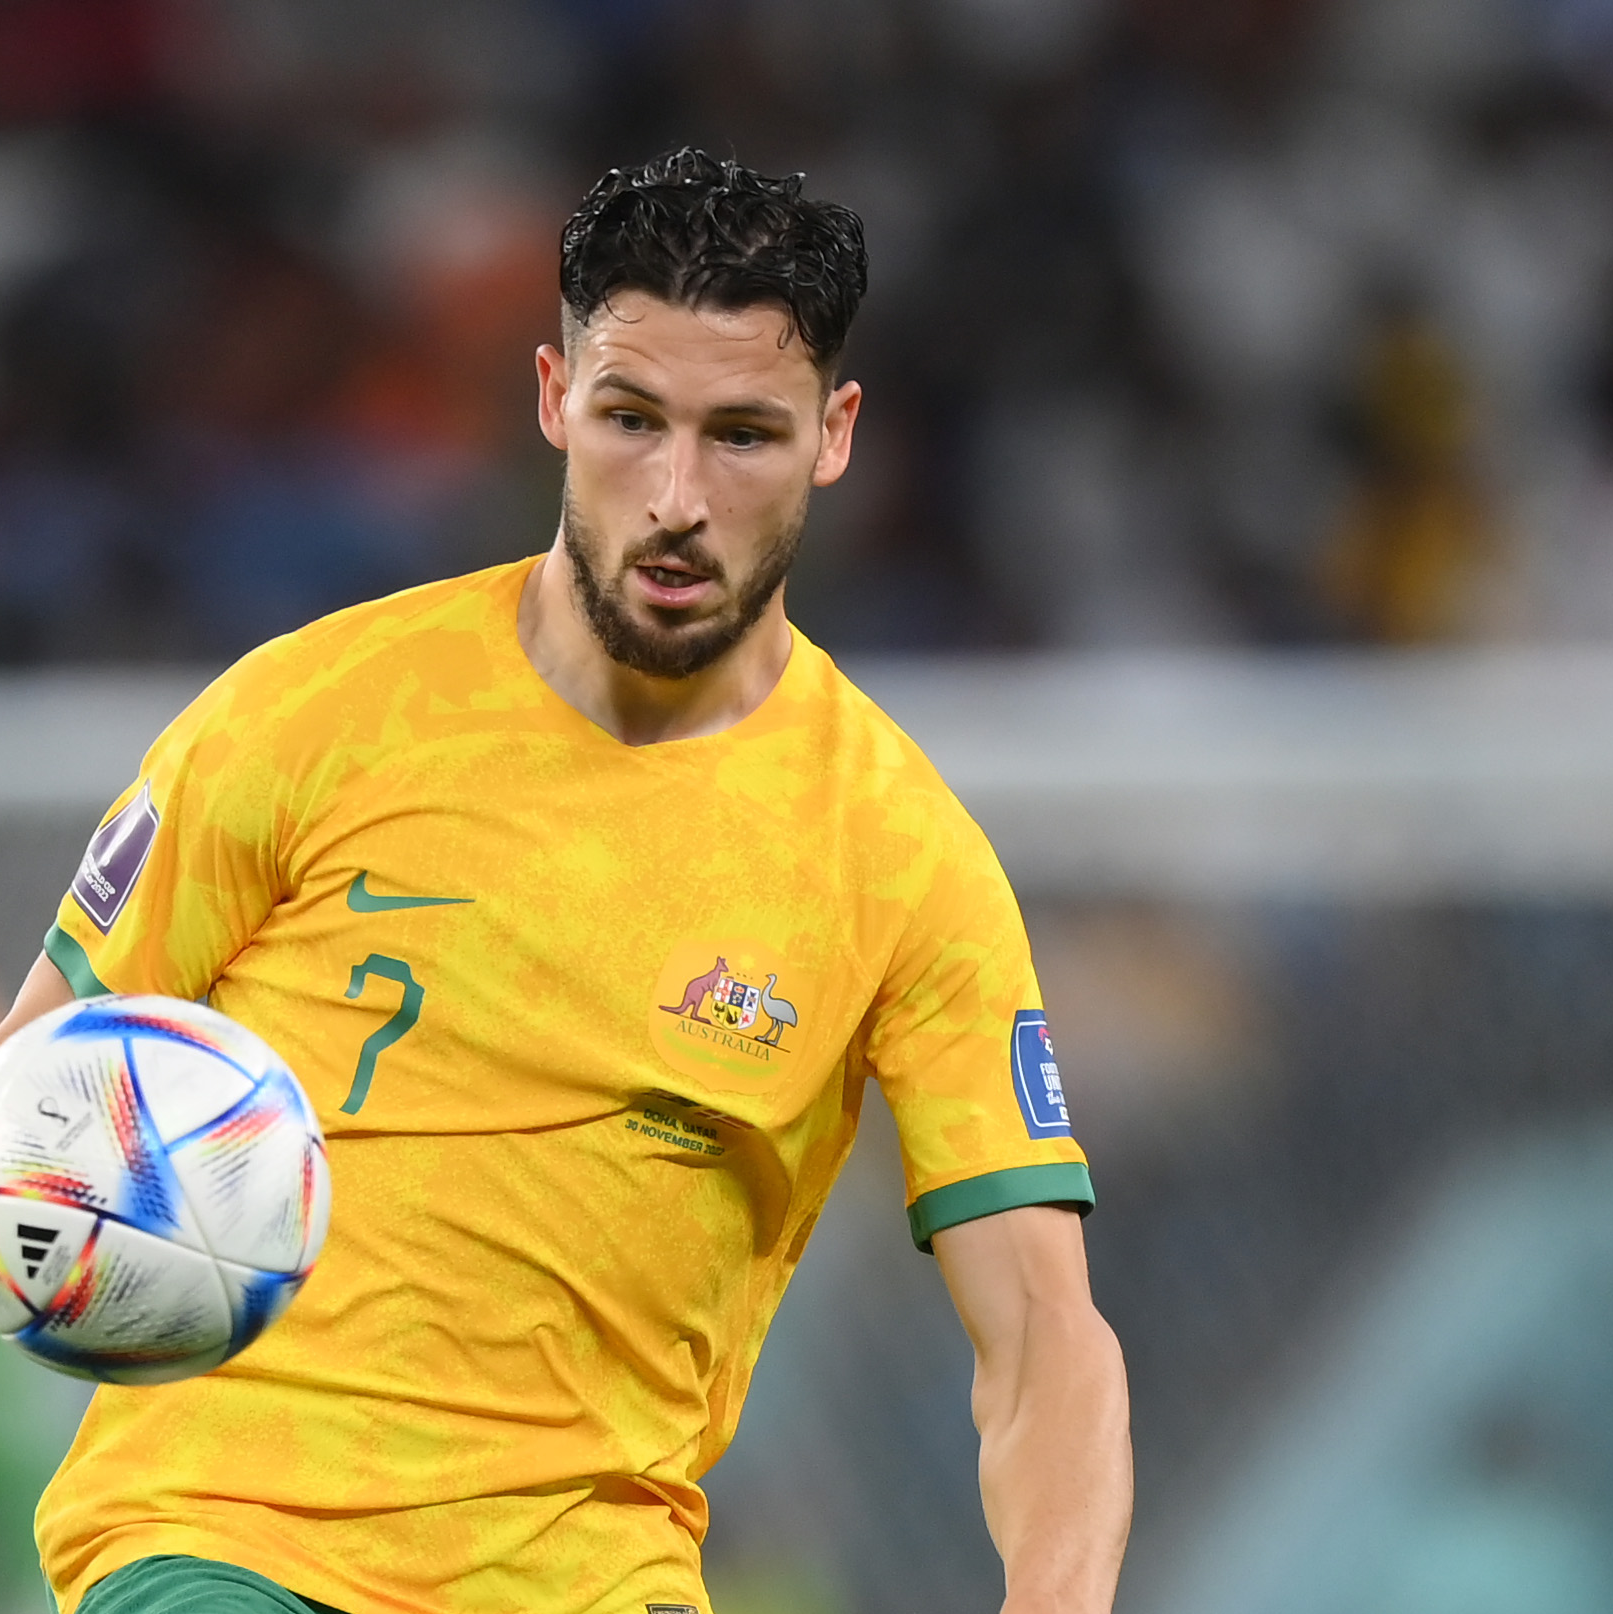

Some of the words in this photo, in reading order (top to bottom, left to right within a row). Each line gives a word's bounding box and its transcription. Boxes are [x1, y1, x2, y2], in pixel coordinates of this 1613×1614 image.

[339, 953, 425, 1116] 7
[675, 1019, 771, 1062] AUSTRALIA
[625, 1118, 638, 1132] 30
[640, 1124, 704, 1153] NOVEMBER
[643, 1108, 679, 1131] DOHA,
[682, 1122, 718, 1140] QATAR
